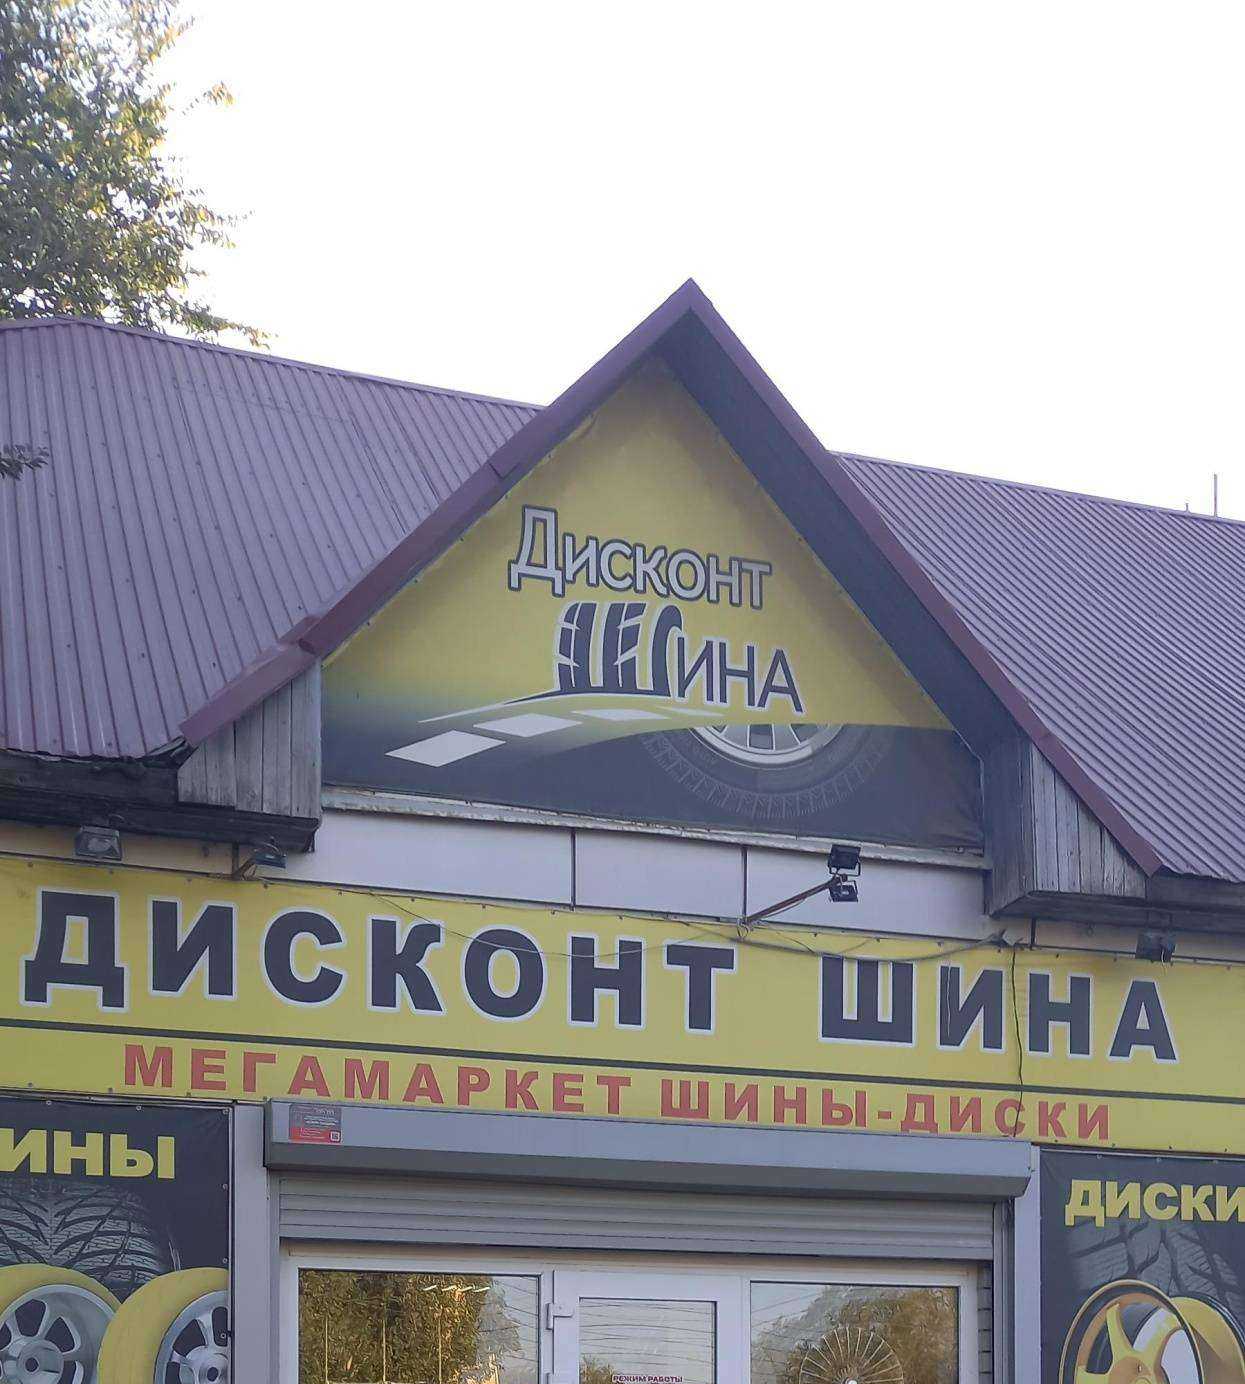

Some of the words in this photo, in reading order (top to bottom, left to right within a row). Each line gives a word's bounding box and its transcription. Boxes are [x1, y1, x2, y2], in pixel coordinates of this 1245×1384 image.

[21, 888, 738, 1033] ДИСКОНТ
[818, 955, 1179, 1062] ШИНА
[123, 1043, 632, 1116] МЕГАМАРКЕТ
[660, 1078, 1111, 1141] ШИНЫ-ДИСКИ
[1064, 1178, 1245, 1228] ДИСКИ
